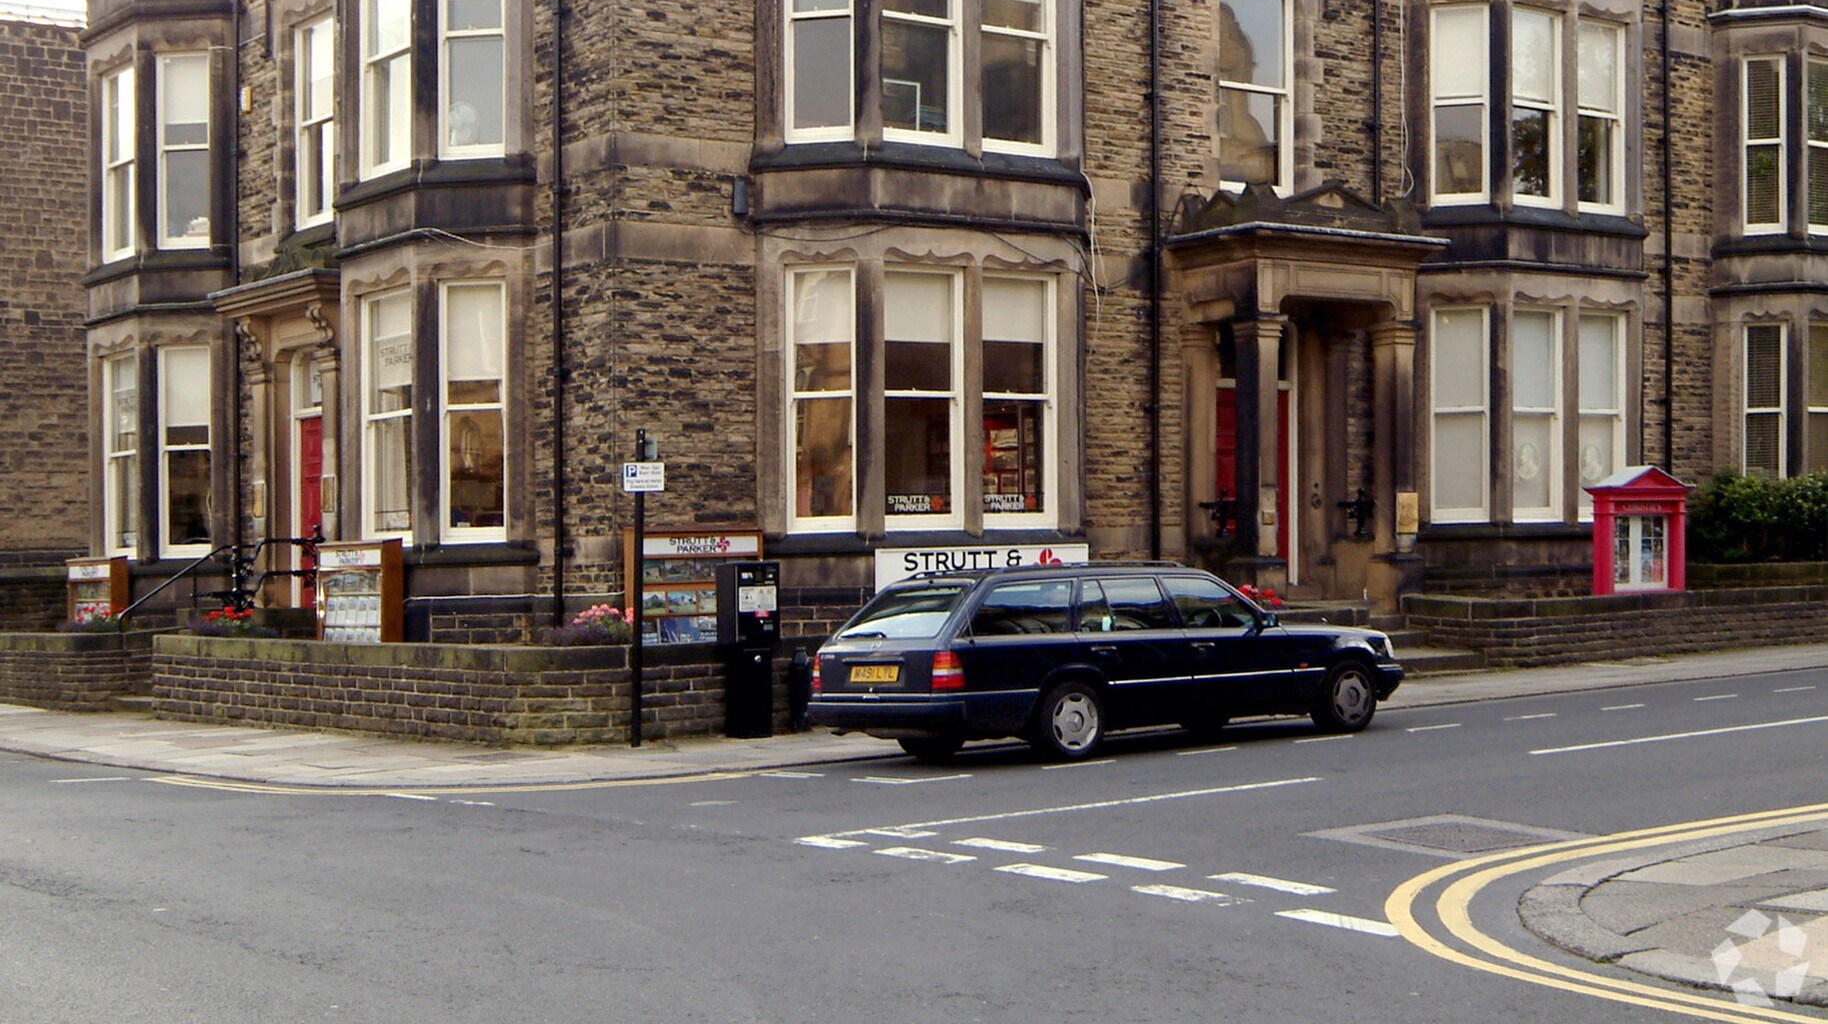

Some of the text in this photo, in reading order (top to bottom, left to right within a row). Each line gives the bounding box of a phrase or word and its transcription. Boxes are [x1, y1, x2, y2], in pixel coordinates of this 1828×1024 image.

[894, 503, 930, 512] PARKER
[991, 501, 1024, 511] PARKER
[677, 544, 716, 554] PARKER
[904, 549, 1022, 571] STRUTT &
